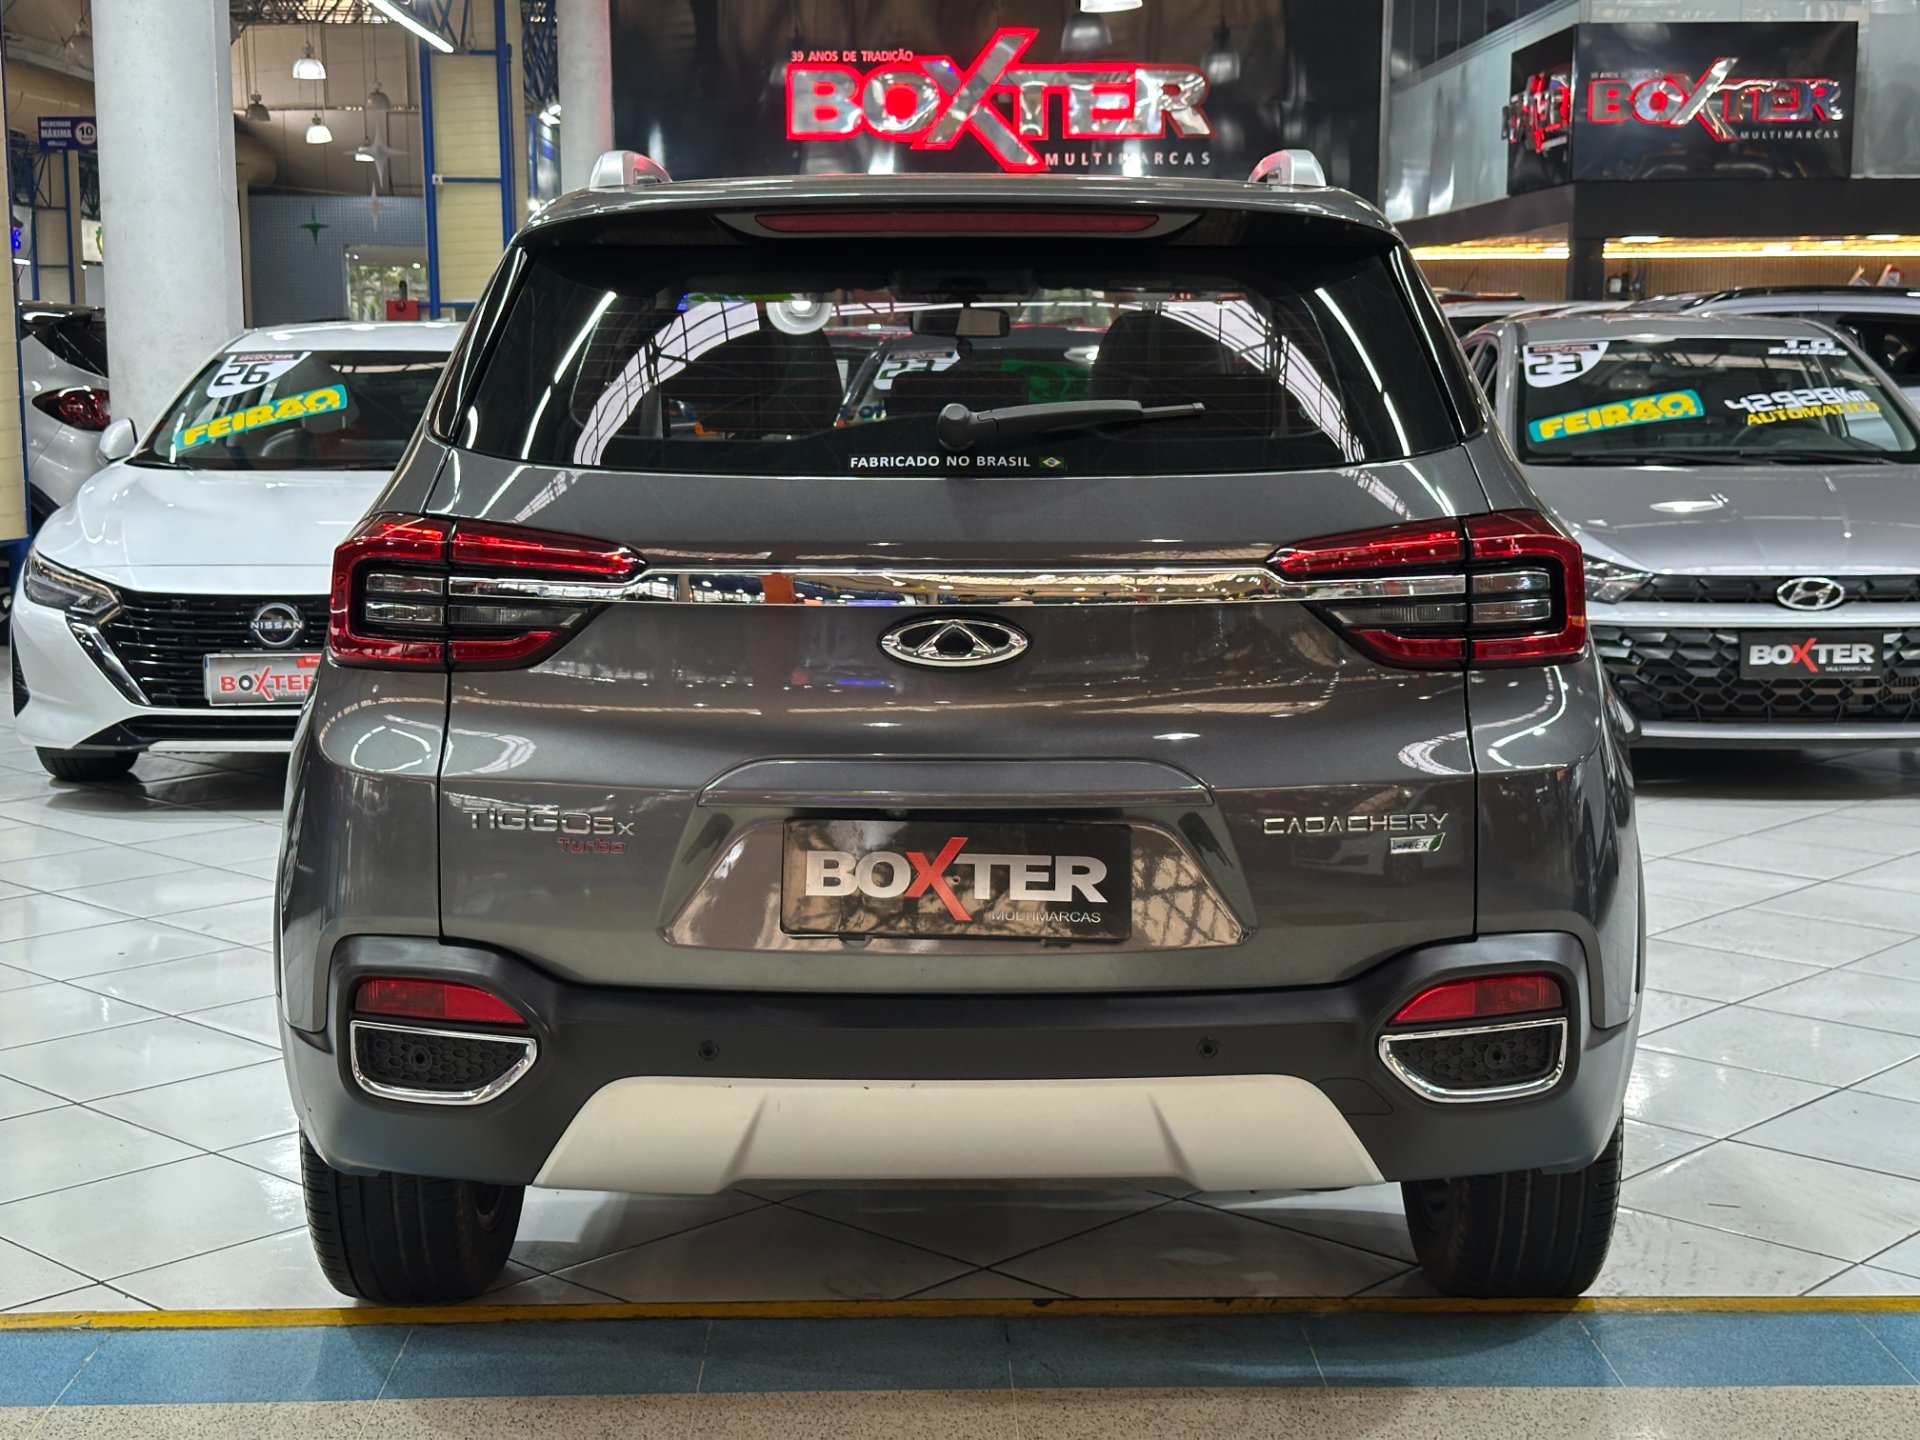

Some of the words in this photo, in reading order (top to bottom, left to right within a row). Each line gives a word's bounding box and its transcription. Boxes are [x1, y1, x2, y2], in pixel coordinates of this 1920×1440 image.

[791, 51, 804, 62] 39
[808, 51, 838, 62] ANOS
[842, 51, 857, 62] DE
[861, 48, 913, 63] TRADIÇÃO
[786, 27, 1217, 171] BOXTER
[1587, 57, 1844, 142] BOXTER
[78, 126, 94, 136] 10
[1740, 130, 1840, 140] MULTIMARCAS
[213, 362, 272, 387] 26
[1528, 352, 1584, 376] 23
[183, 388, 340, 446] FEIRÃO
[1539, 393, 1697, 439] FEIRÃO
[850, 455, 940, 468] FABRICADO
[946, 455, 970, 467] NO
[976, 456, 1031, 467] BRASIL
[250, 620, 303, 630] NISSAN
[1749, 637, 1875, 673] BOXTER
[805, 836, 1108, 922] BOXTER
[990, 910, 1101, 923] MULTIMARCAS
